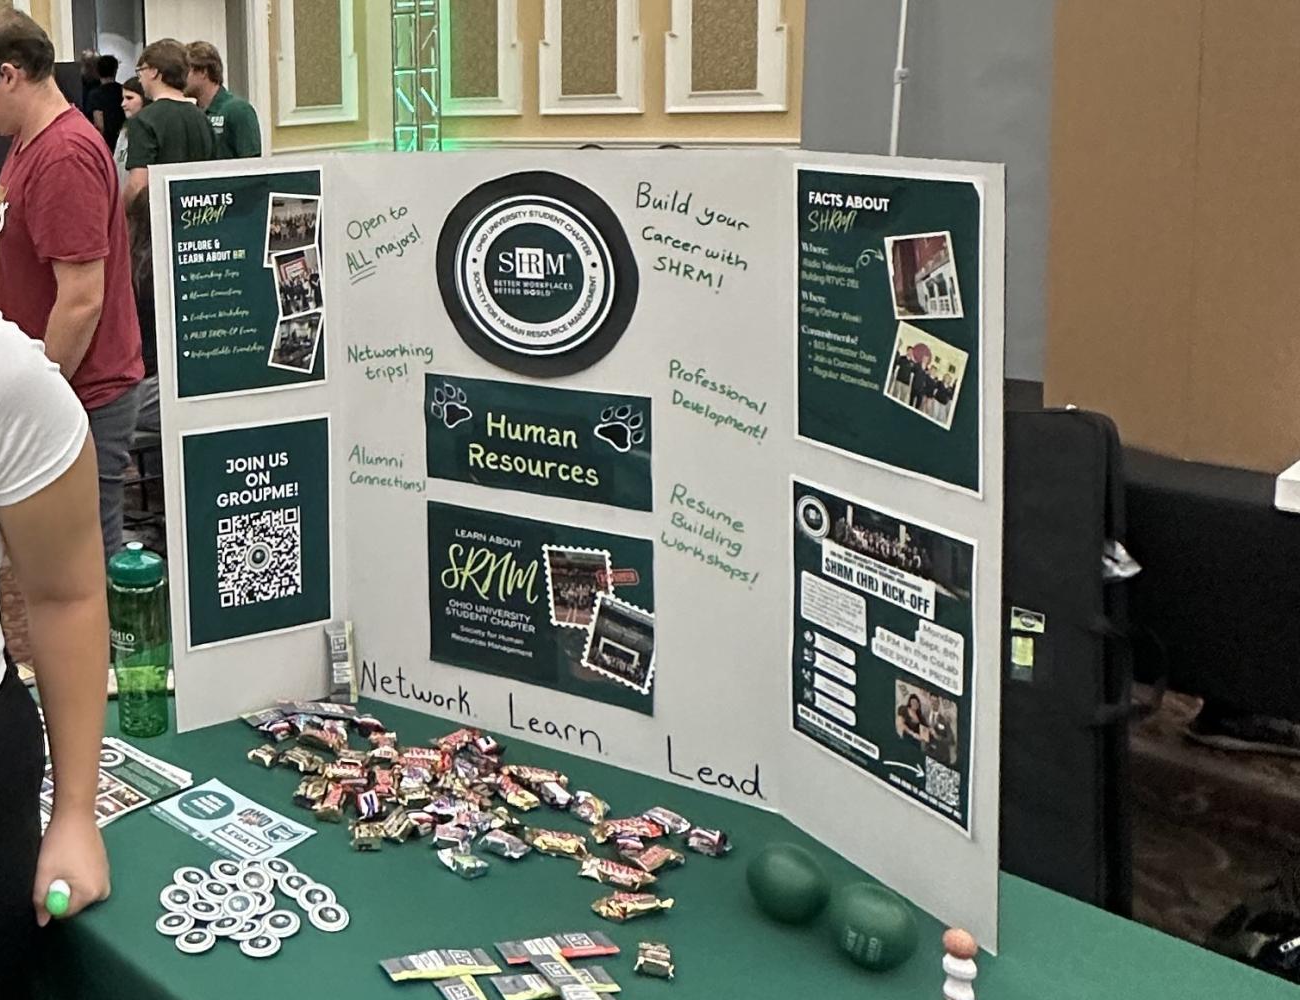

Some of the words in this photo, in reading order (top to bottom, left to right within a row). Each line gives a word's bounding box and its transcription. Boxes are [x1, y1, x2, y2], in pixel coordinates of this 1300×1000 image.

[180, 194, 219, 208] WHAT
[221, 193, 234, 205] IS
[636, 181, 692, 215] Build
[696, 207, 749, 231] your
[808, 191, 844, 207] FACTS
[845, 195, 890, 212] ABOUT
[346, 213, 387, 240] Open
[390, 206, 408, 220] to
[475, 232, 488, 253] OHIO
[486, 210, 528, 236] UNIVERSITY
[529, 210, 565, 227] STUDENT
[564, 223, 593, 257] CHAPTER
[177, 239, 213, 253] EXPLORE
[214, 238, 221, 250] &
[178, 252, 205, 265] LEARN
[206, 250, 231, 262] ABOUT
[345, 249, 373, 275] ALL
[374, 223, 425, 259] majors!
[642, 226, 701, 254] Career
[705, 249, 748, 271] with
[522, 280, 573, 290] WORKPLACES
[653, 256, 723, 294] SHRM!
[472, 271, 488, 304] SOCIETY
[484, 302, 498, 320] FOR
[496, 315, 526, 336] HUMAN
[526, 324, 569, 338] RESOURCE
[568, 275, 597, 328] MANAGEMENT
[347, 343, 433, 365] Networking
[365, 362, 410, 383] trips!
[668, 359, 767, 415] Professional
[486, 412, 578, 449] Human
[672, 389, 768, 446] Development!
[226, 456, 265, 474] JOIN
[268, 452, 289, 469] US
[349, 444, 405, 469] Alumni
[468, 443, 600, 486] Resources
[245, 471, 270, 488] ON
[349, 470, 427, 493] Connections!
[216, 482, 299, 508] GROUPME!
[670, 483, 745, 533] Resume
[455, 528, 487, 542] LEARN
[488, 535, 522, 548] ABOUT
[670, 511, 743, 557] Building
[660, 531, 760, 590] Workshops!
[825, 557, 853, 582] SHRM
[856, 570, 879, 593] (HR)
[881, 580, 930, 614] KICK-OFF
[445, 606, 488, 623] STUDENT
[490, 616, 536, 634] CHAPTER
[448, 599, 473, 611] OHIO
[474, 604, 531, 623] UNIVERSITY
[922, 623, 960, 648] Monday
